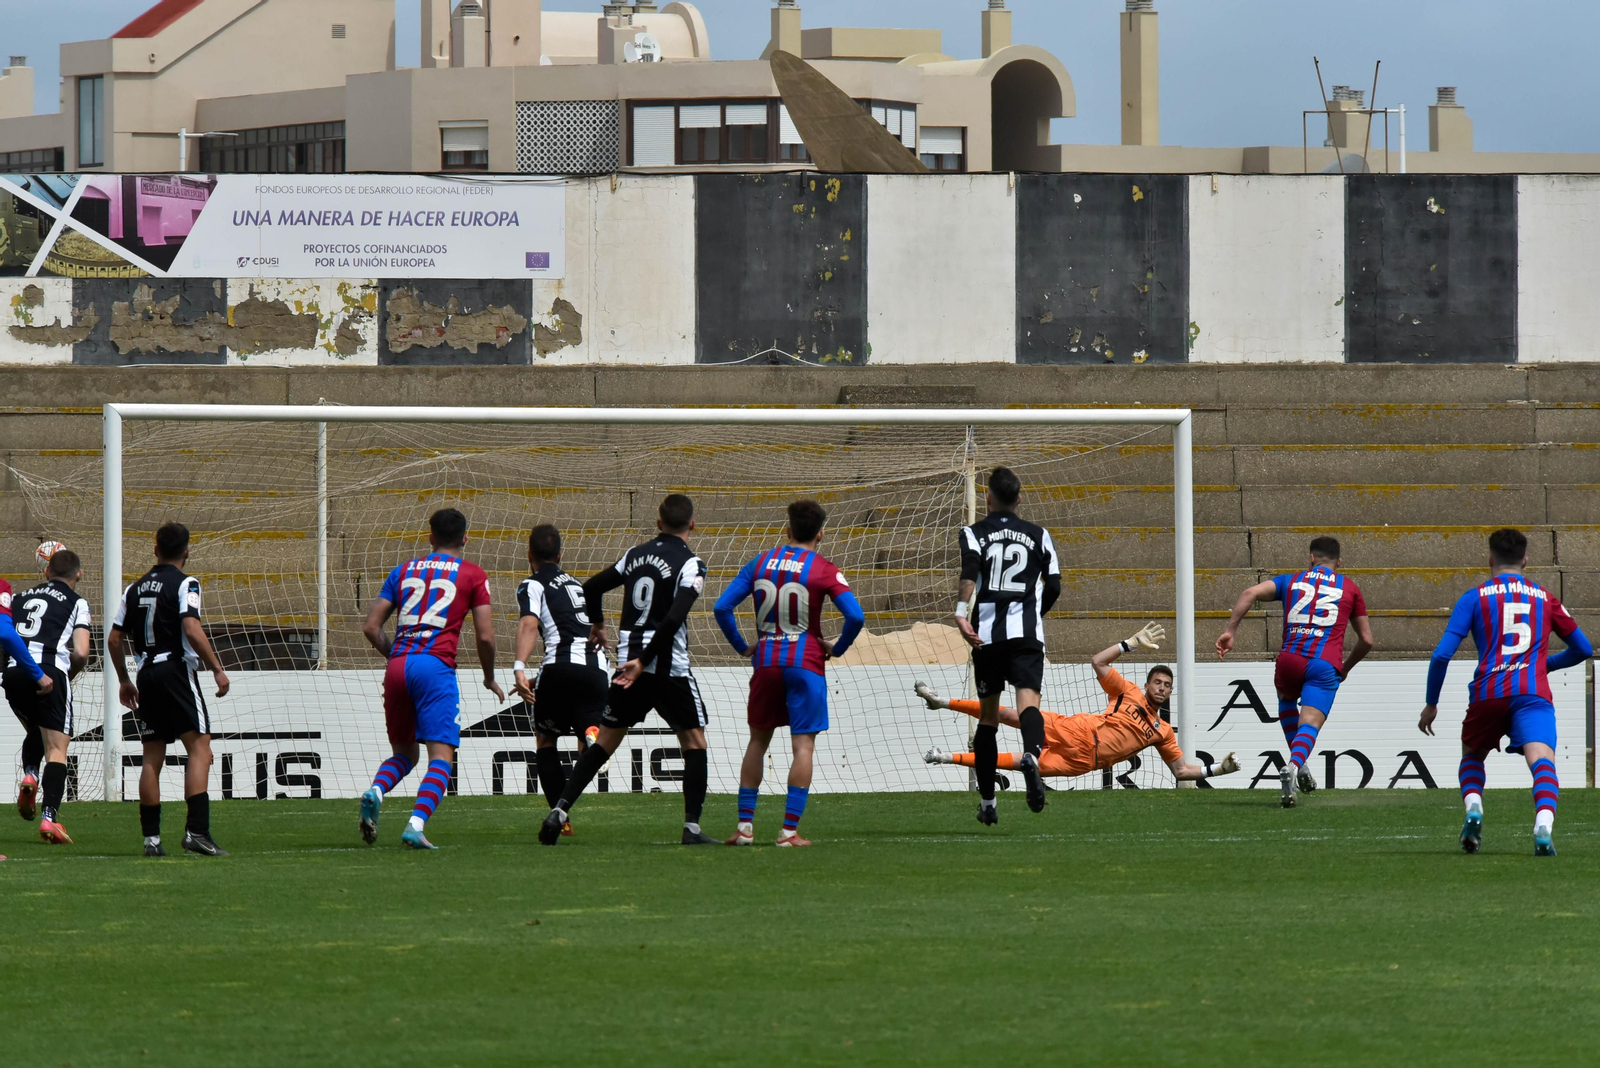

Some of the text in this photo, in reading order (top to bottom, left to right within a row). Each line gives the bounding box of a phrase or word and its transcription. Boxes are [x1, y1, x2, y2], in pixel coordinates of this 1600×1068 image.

[255, 185, 494, 196] FONDOS EUROPEOS DE DESARROLLO REGIONAL (FEDER)
[232, 210, 520, 227] UNA MANERA DE HACER EUROPA
[303, 244, 447, 254] PROYECTOS COFINANCIADOS
[315, 256, 435, 267] POR LA UNIÓN EUROPEA
[988, 528, 1036, 550] MONTEVERDE
[416, 560, 460, 572] ESCOBAR
[645, 554, 672, 580] MARTÍN
[766, 558, 804, 574] EZ ABDE
[985, 542, 1028, 593] 12
[21, 586, 67, 602] SAMANES
[137, 580, 163, 595] LOREN
[1479, 580, 1548, 602] MIKA MÁRMOL
[398, 577, 457, 629] 22
[564, 585, 594, 625] 5
[632, 576, 655, 627] 9
[754, 578, 810, 635] 20
[1287, 581, 1343, 627] 23
[16, 598, 49, 638] 3
[138, 597, 157, 647] 7
[1501, 602, 1532, 655] 5
[1289, 626, 1314, 635] unicef
[1125, 704, 1154, 740] LOTUS
